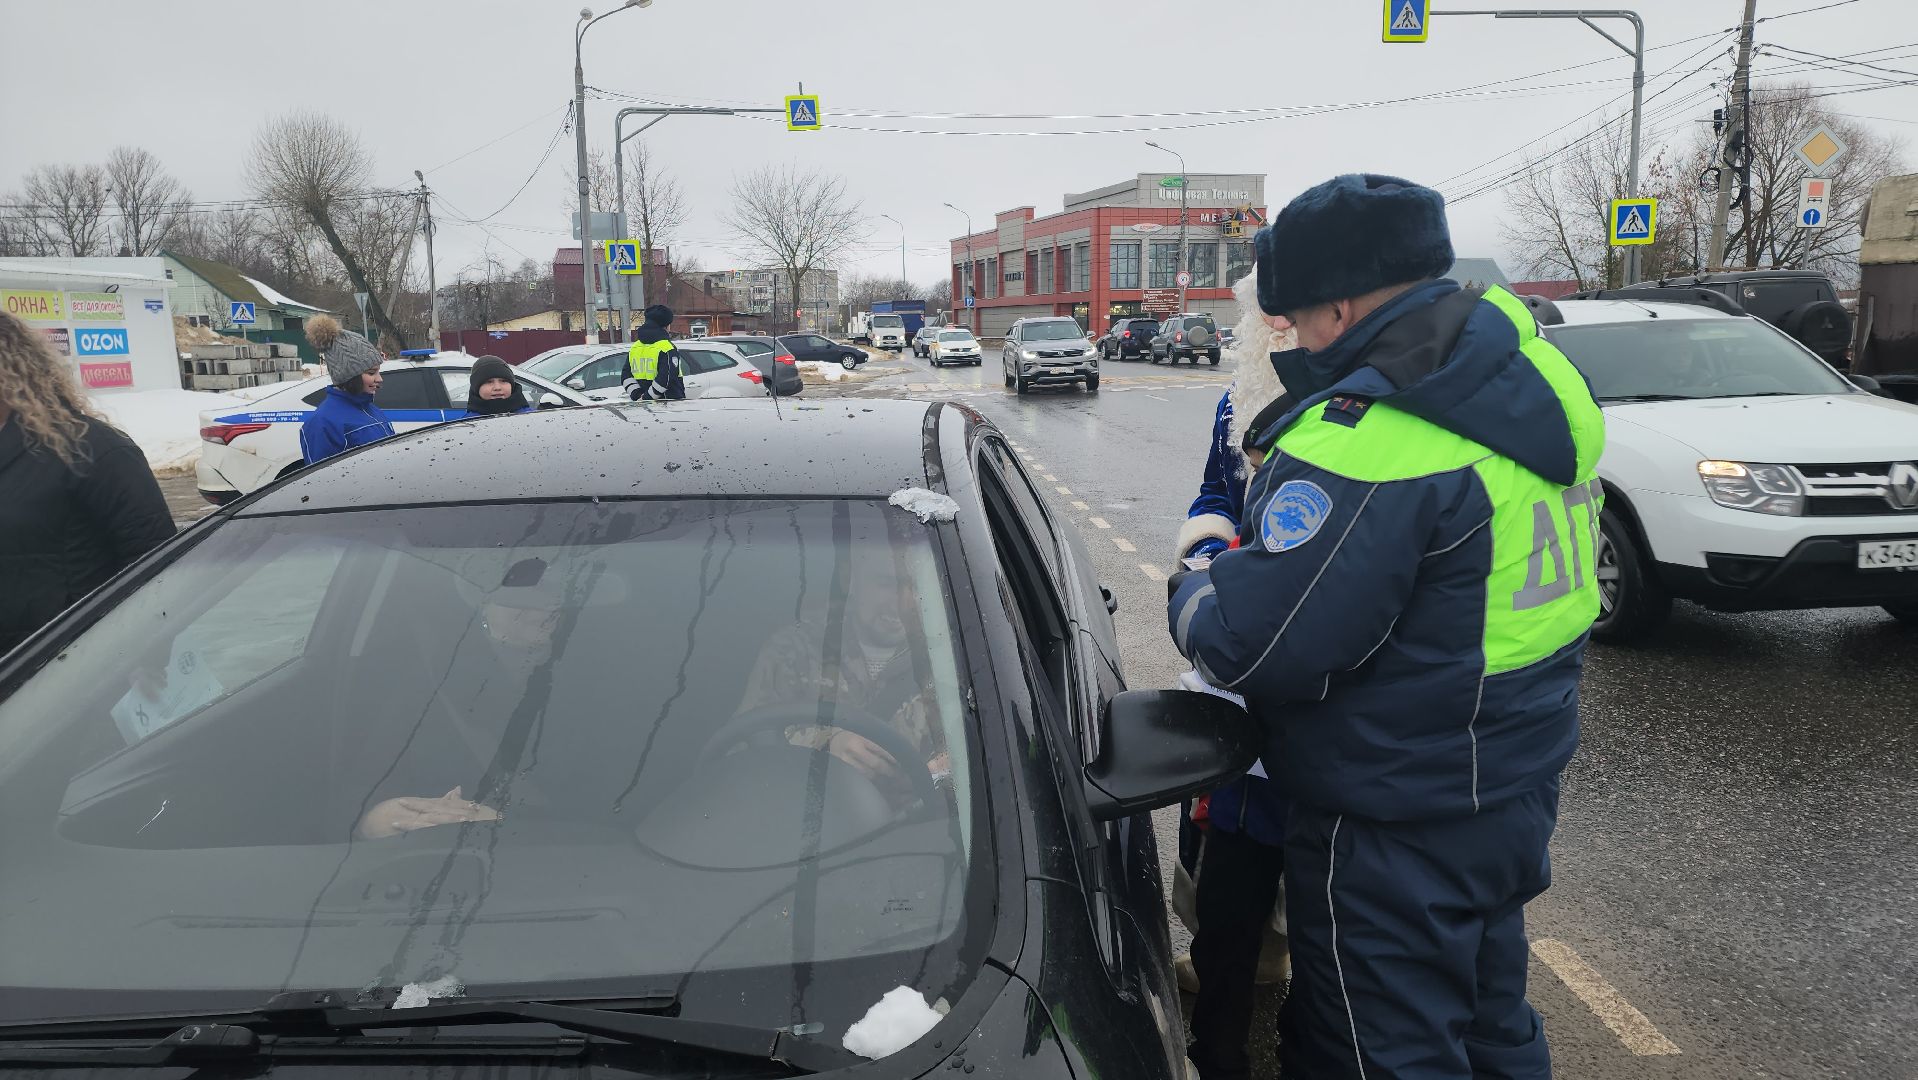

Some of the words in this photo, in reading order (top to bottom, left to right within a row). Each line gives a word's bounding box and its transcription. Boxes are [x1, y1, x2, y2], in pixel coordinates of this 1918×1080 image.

[1211, 188, 1249, 200] Техника
[8, 296, 49, 314] ОКНА
[72, 302, 84, 312] ВСЕ
[86, 302, 99, 312] ДЛЯ
[81, 333, 124, 352] OZON
[631, 357, 654, 373] ДПС
